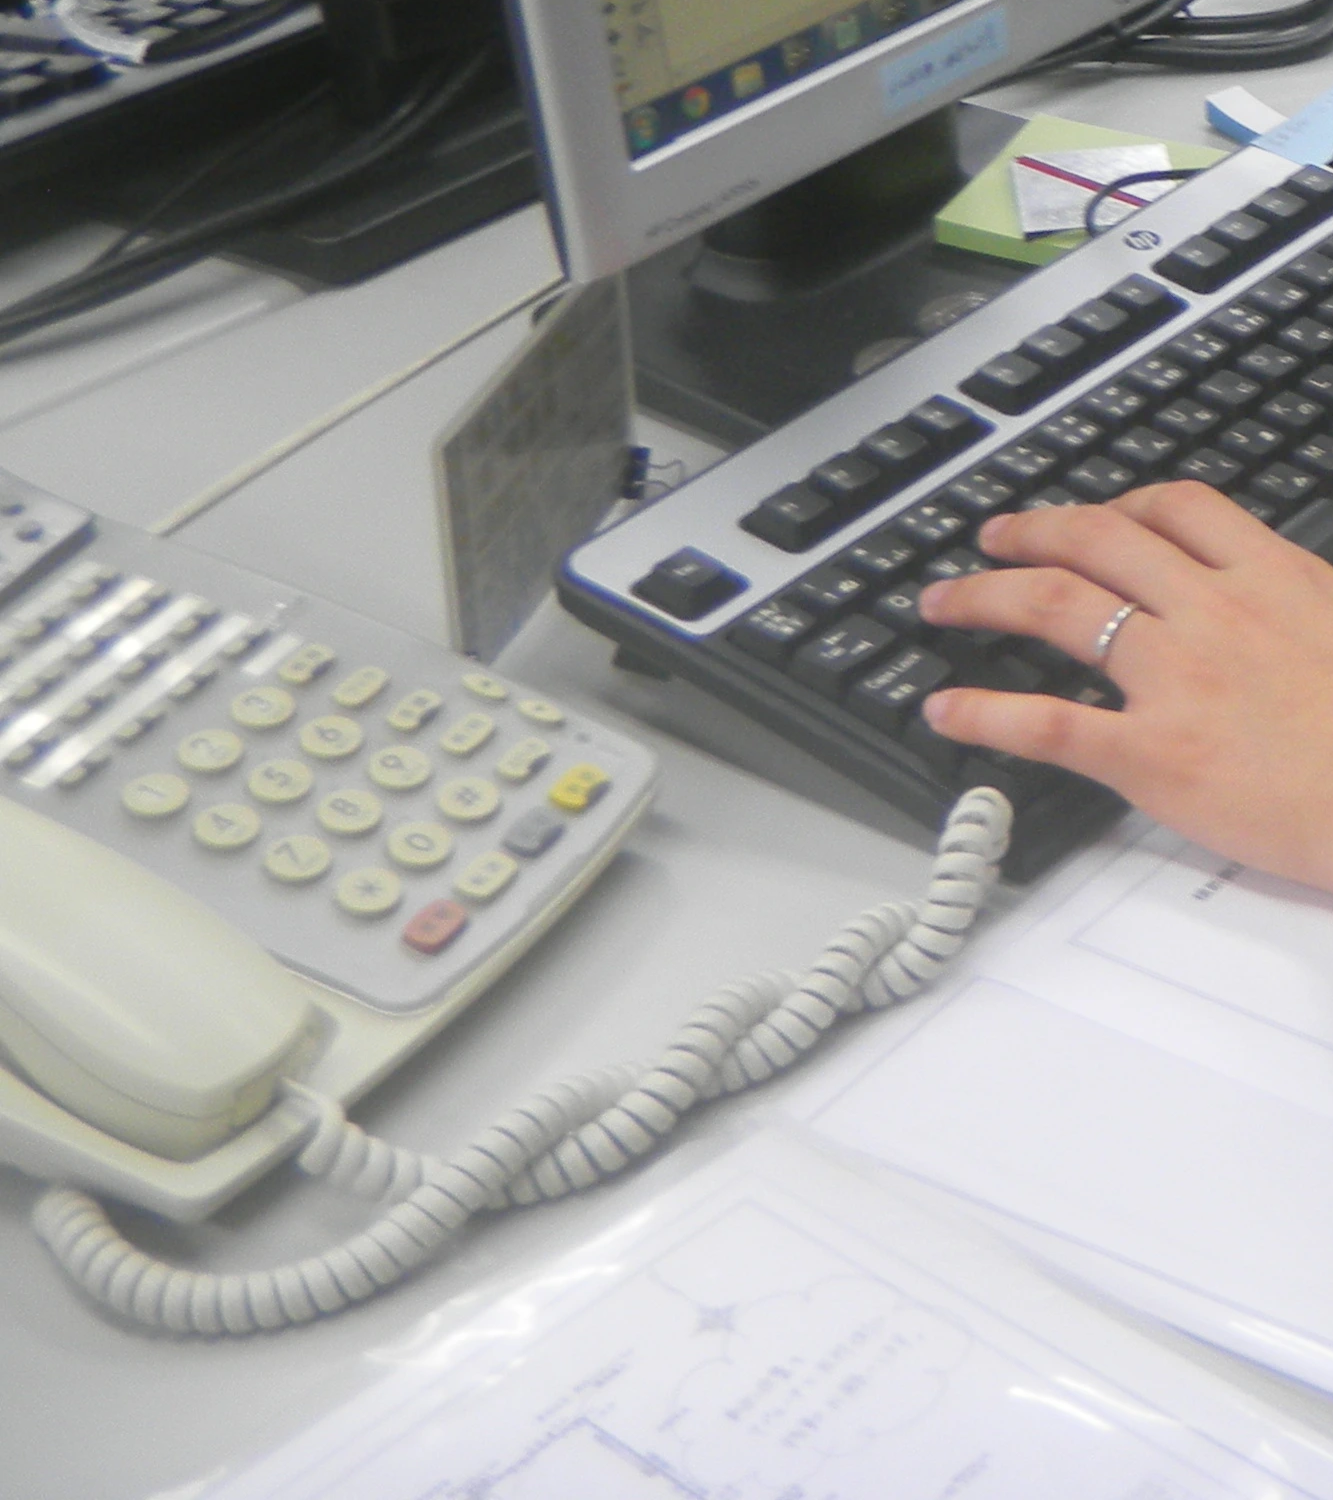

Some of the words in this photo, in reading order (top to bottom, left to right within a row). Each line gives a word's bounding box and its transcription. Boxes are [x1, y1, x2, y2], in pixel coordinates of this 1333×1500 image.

[1123, 230, 1161, 251] hp
[314, 725, 343, 742] 6
[379, 753, 407, 772] 9
[263, 766, 293, 788] 5
[330, 798, 361, 817] 8
[209, 812, 236, 831] 4
[404, 832, 435, 851] 0
[272, 841, 302, 865] 7
